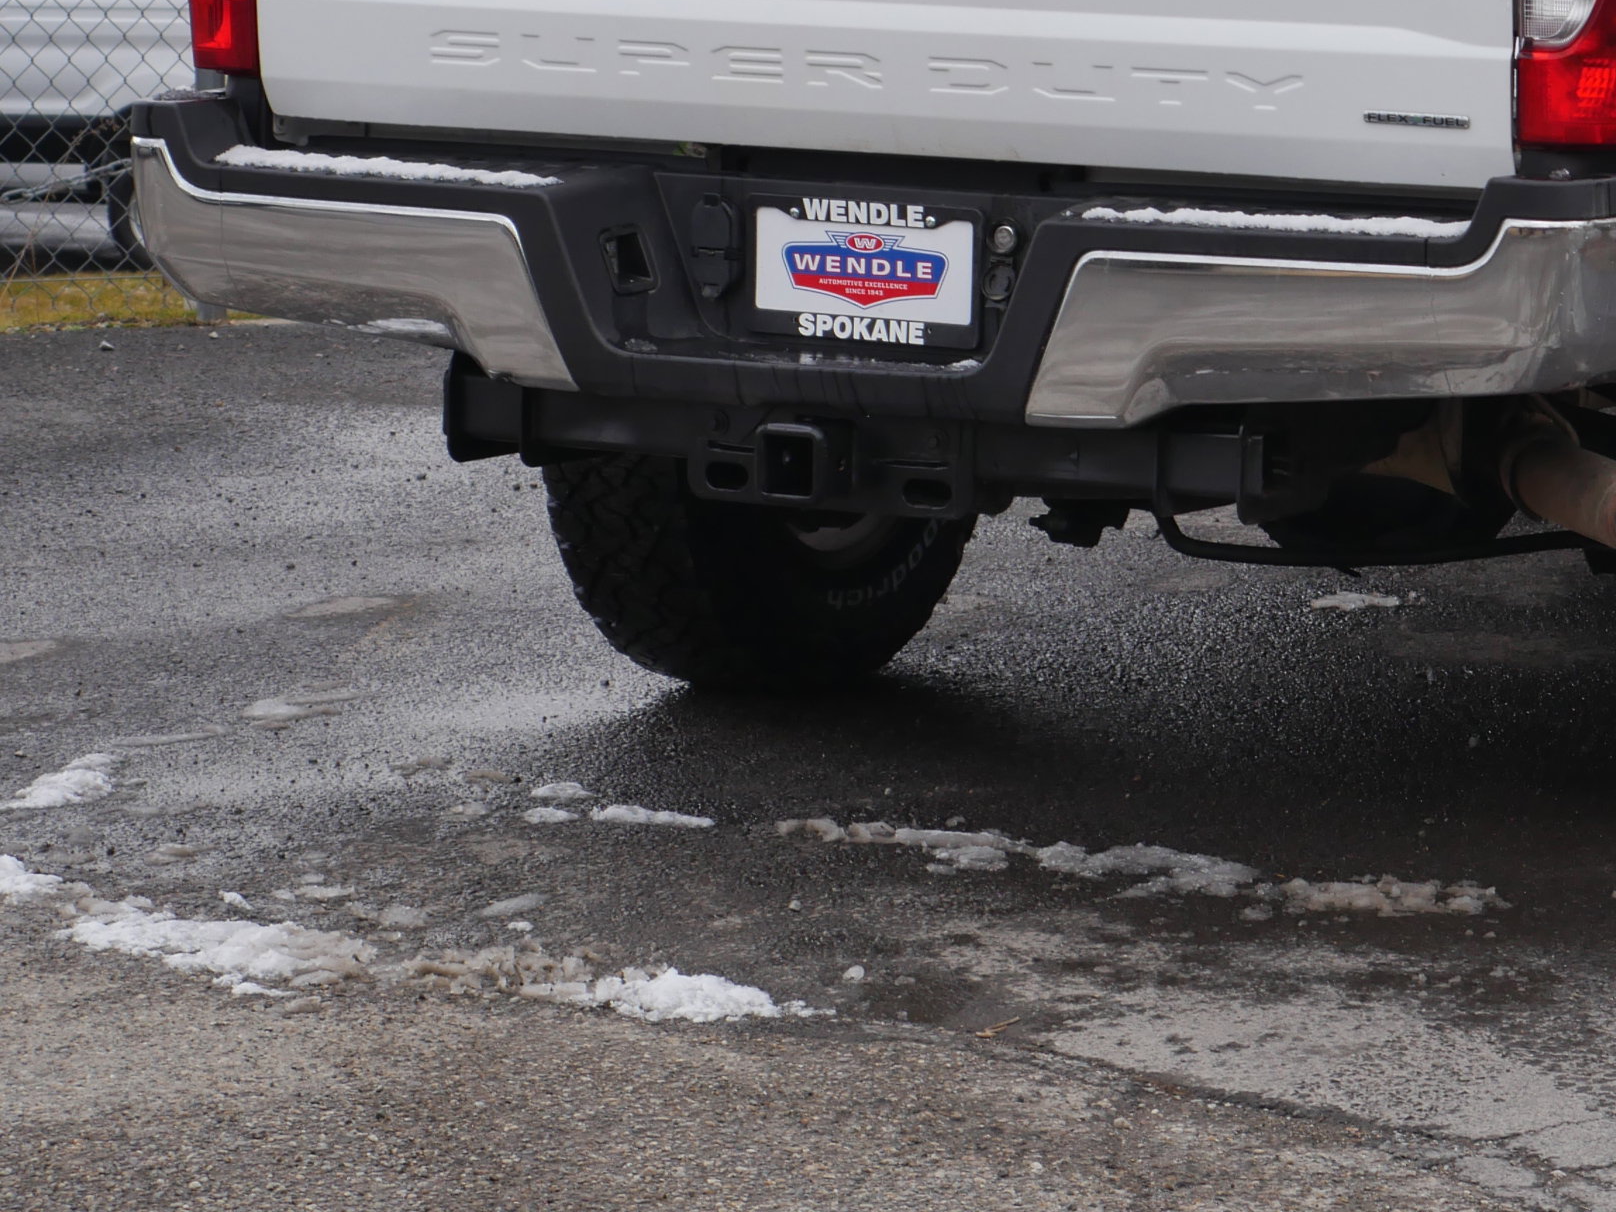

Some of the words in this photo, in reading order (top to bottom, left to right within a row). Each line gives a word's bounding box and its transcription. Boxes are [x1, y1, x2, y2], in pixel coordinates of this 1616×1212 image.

[430, 29, 883, 89] SUPER
[927, 55, 1304, 111] DUTY
[1367, 112, 1409, 124] FLEX
[1422, 115, 1467, 127] FUEL
[802, 197, 925, 228] WENDLE
[793, 253, 933, 279] WENDLE
[818, 277, 863, 287] AUTOMOTIVE
[864, 280, 908, 290] EXCELLENCE
[798, 313, 925, 346] SPOKANE
